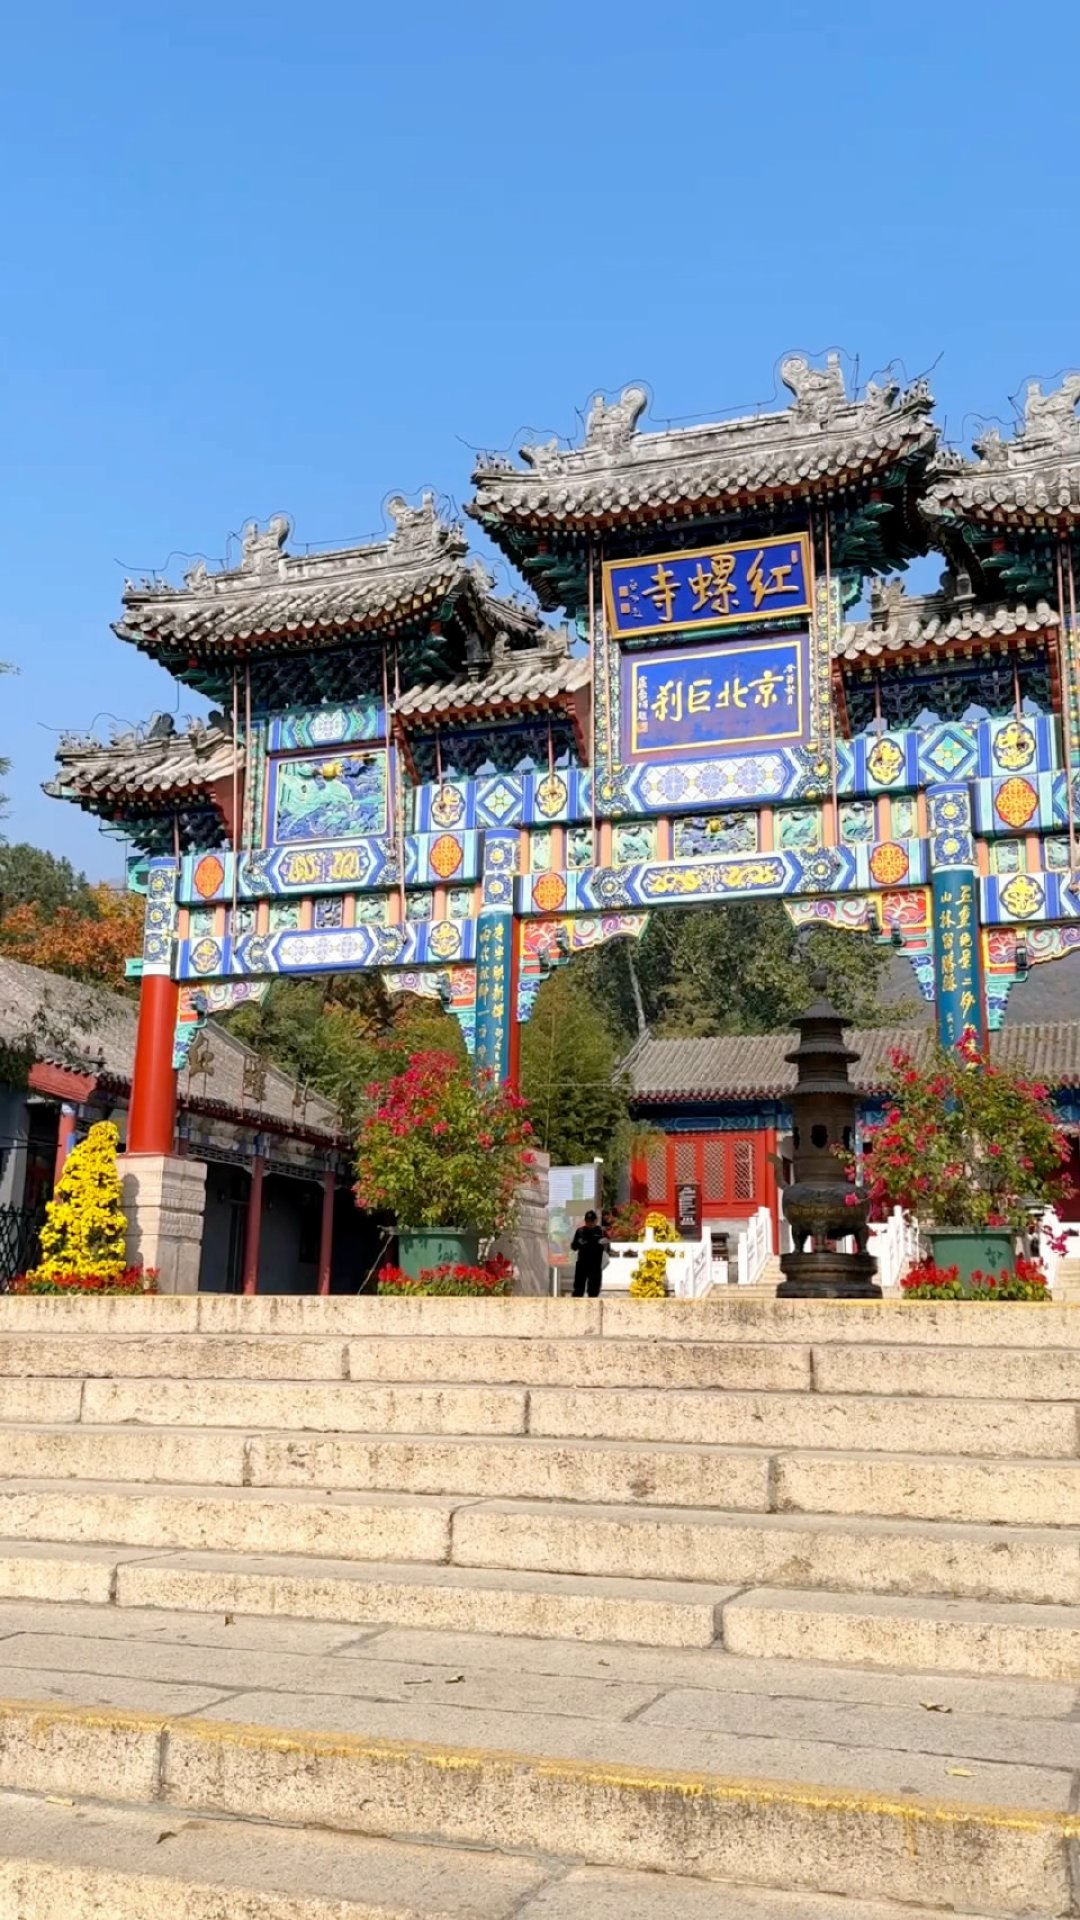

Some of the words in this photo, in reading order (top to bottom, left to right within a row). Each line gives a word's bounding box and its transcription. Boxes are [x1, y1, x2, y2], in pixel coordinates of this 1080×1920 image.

[641, 550, 799, 622] 红螺寺
[651, 670, 784, 722] 京北巨刹
